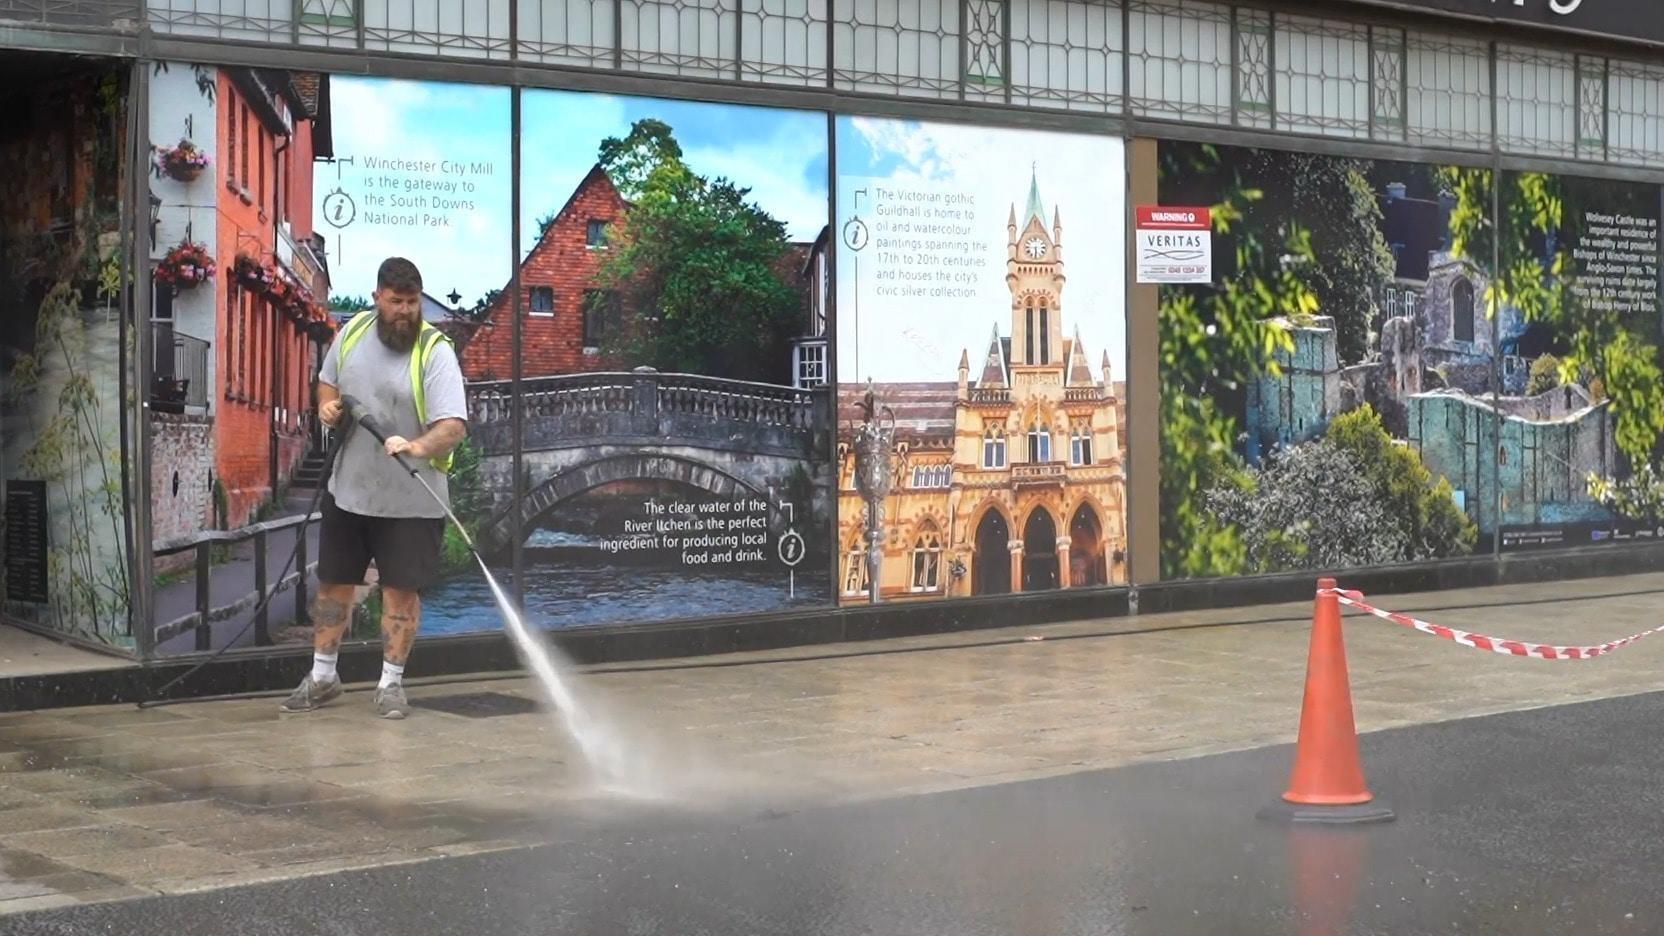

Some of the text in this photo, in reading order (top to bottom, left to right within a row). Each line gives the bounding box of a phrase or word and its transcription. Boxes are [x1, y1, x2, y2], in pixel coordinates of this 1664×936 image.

[364, 156, 492, 176] Winchester City Mill
[364, 176, 474, 194] is the gateway to
[365, 194, 474, 210] the South Downs
[876, 188, 974, 206] The Victorian gothic
[364, 212, 418, 225] National
[877, 204, 974, 220] Guildhall is home to
[1151, 212, 1187, 221] WARNING
[1616, 214, 1634, 224] Castle
[1636, 218, 1647, 226] was
[876, 222, 970, 235] oil and watercolour
[1589, 225, 1619, 236] important
[1649, 229, 1656, 239] of
[877, 238, 987, 253] paintings spanning the
[1148, 236, 1200, 247] VERITAS
[1580, 237, 1590, 246] the
[1617, 240, 1629, 249] and
[878, 252, 985, 266] 17th to 20th centuries
[1574, 248, 1597, 261] Bishops
[1599, 250, 1605, 260] of
[1606, 251, 1640, 262] Winchester
[877, 270, 895, 280] and
[899, 269, 931, 280] houses
[936, 270, 950, 281] the
[1645, 265, 1656, 275] The
[877, 286, 898, 295] civic
[902, 284, 926, 296] silver
[1590, 287, 1600, 297] the
[1632, 302, 1639, 310] of
[644, 499, 766, 514] The clear water of the
[625, 517, 766, 532] River Itchen is the perfect
[600, 532, 766, 553] ingredient for producing local
[682, 549, 766, 564] food and drink.
